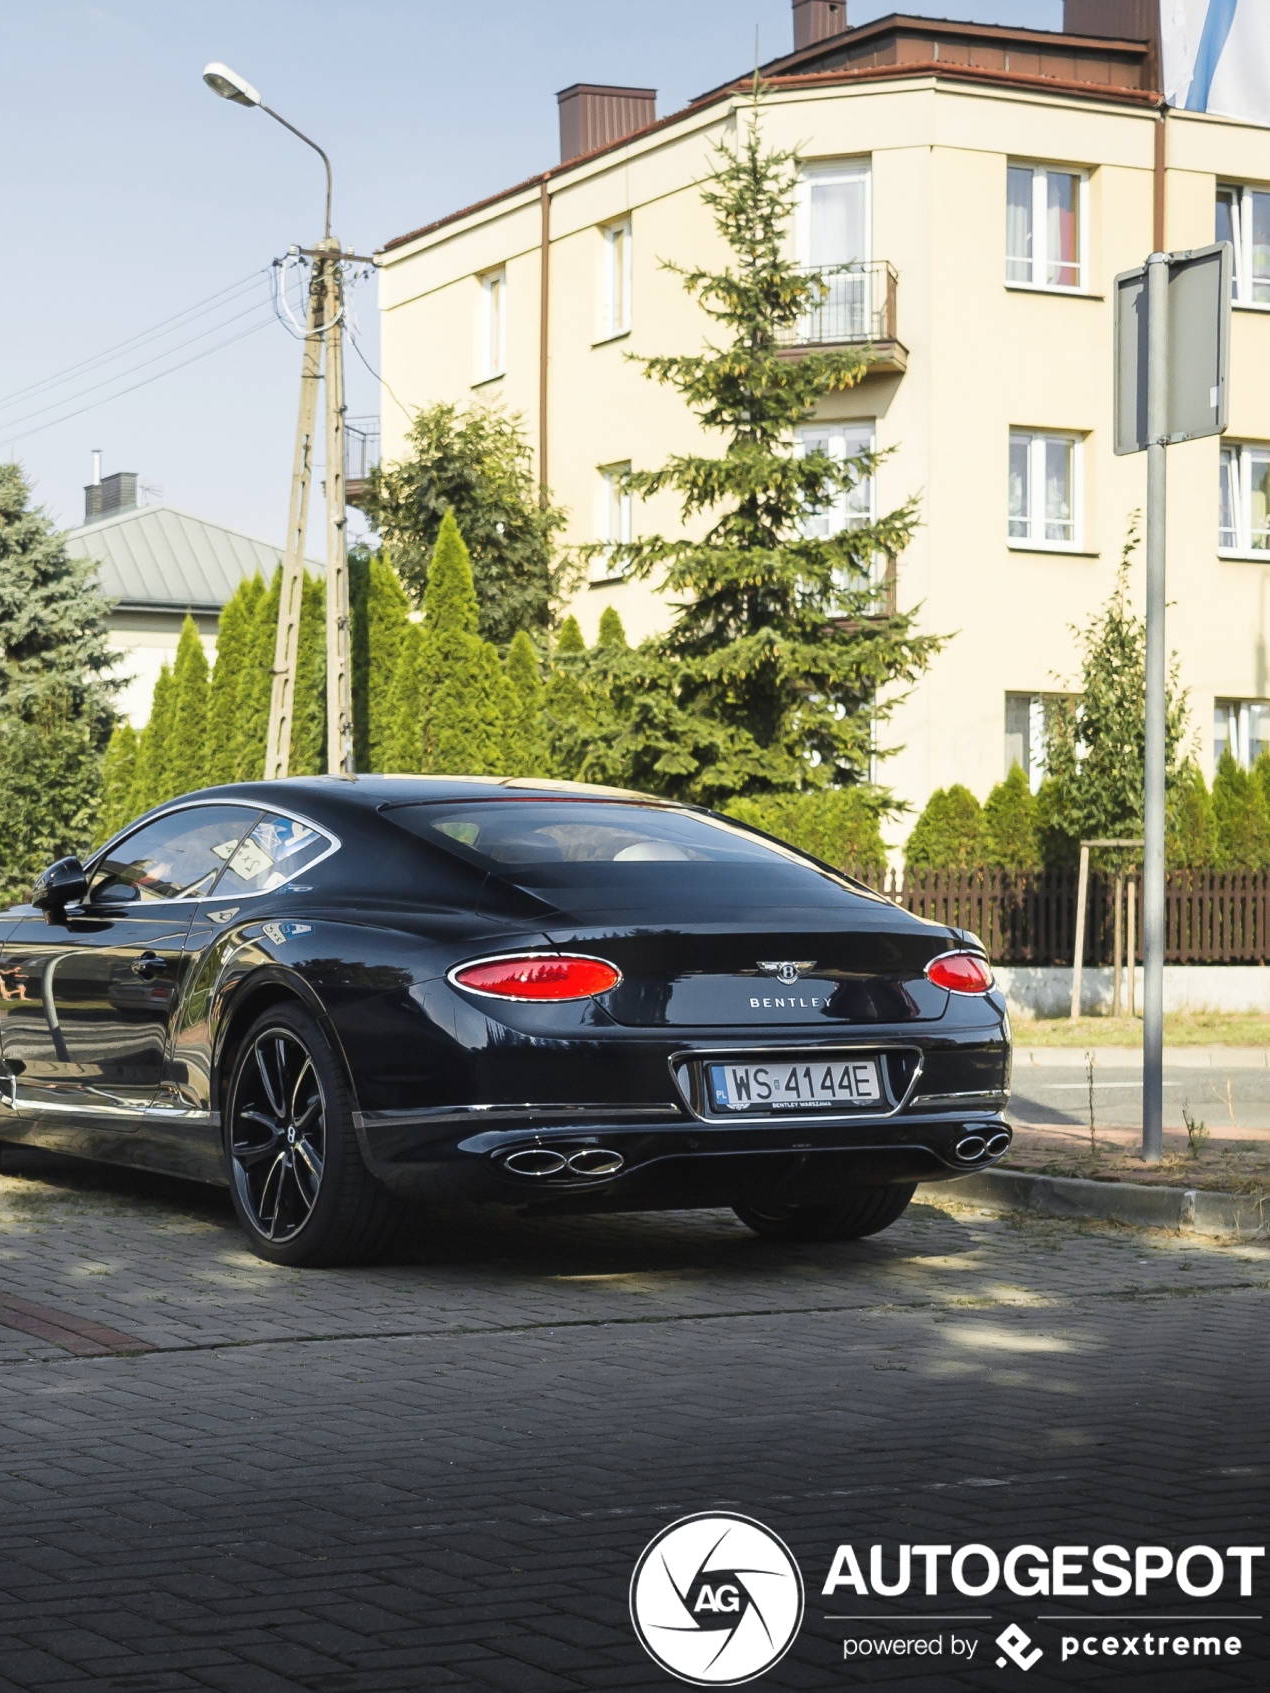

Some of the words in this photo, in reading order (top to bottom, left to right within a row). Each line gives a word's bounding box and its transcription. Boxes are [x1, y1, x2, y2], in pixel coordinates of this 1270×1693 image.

[749, 997, 832, 1009] BENTLEY
[731, 1067, 772, 1101] WS
[785, 1064, 872, 1099] 4144E
[716, 1089, 727, 1101] PL
